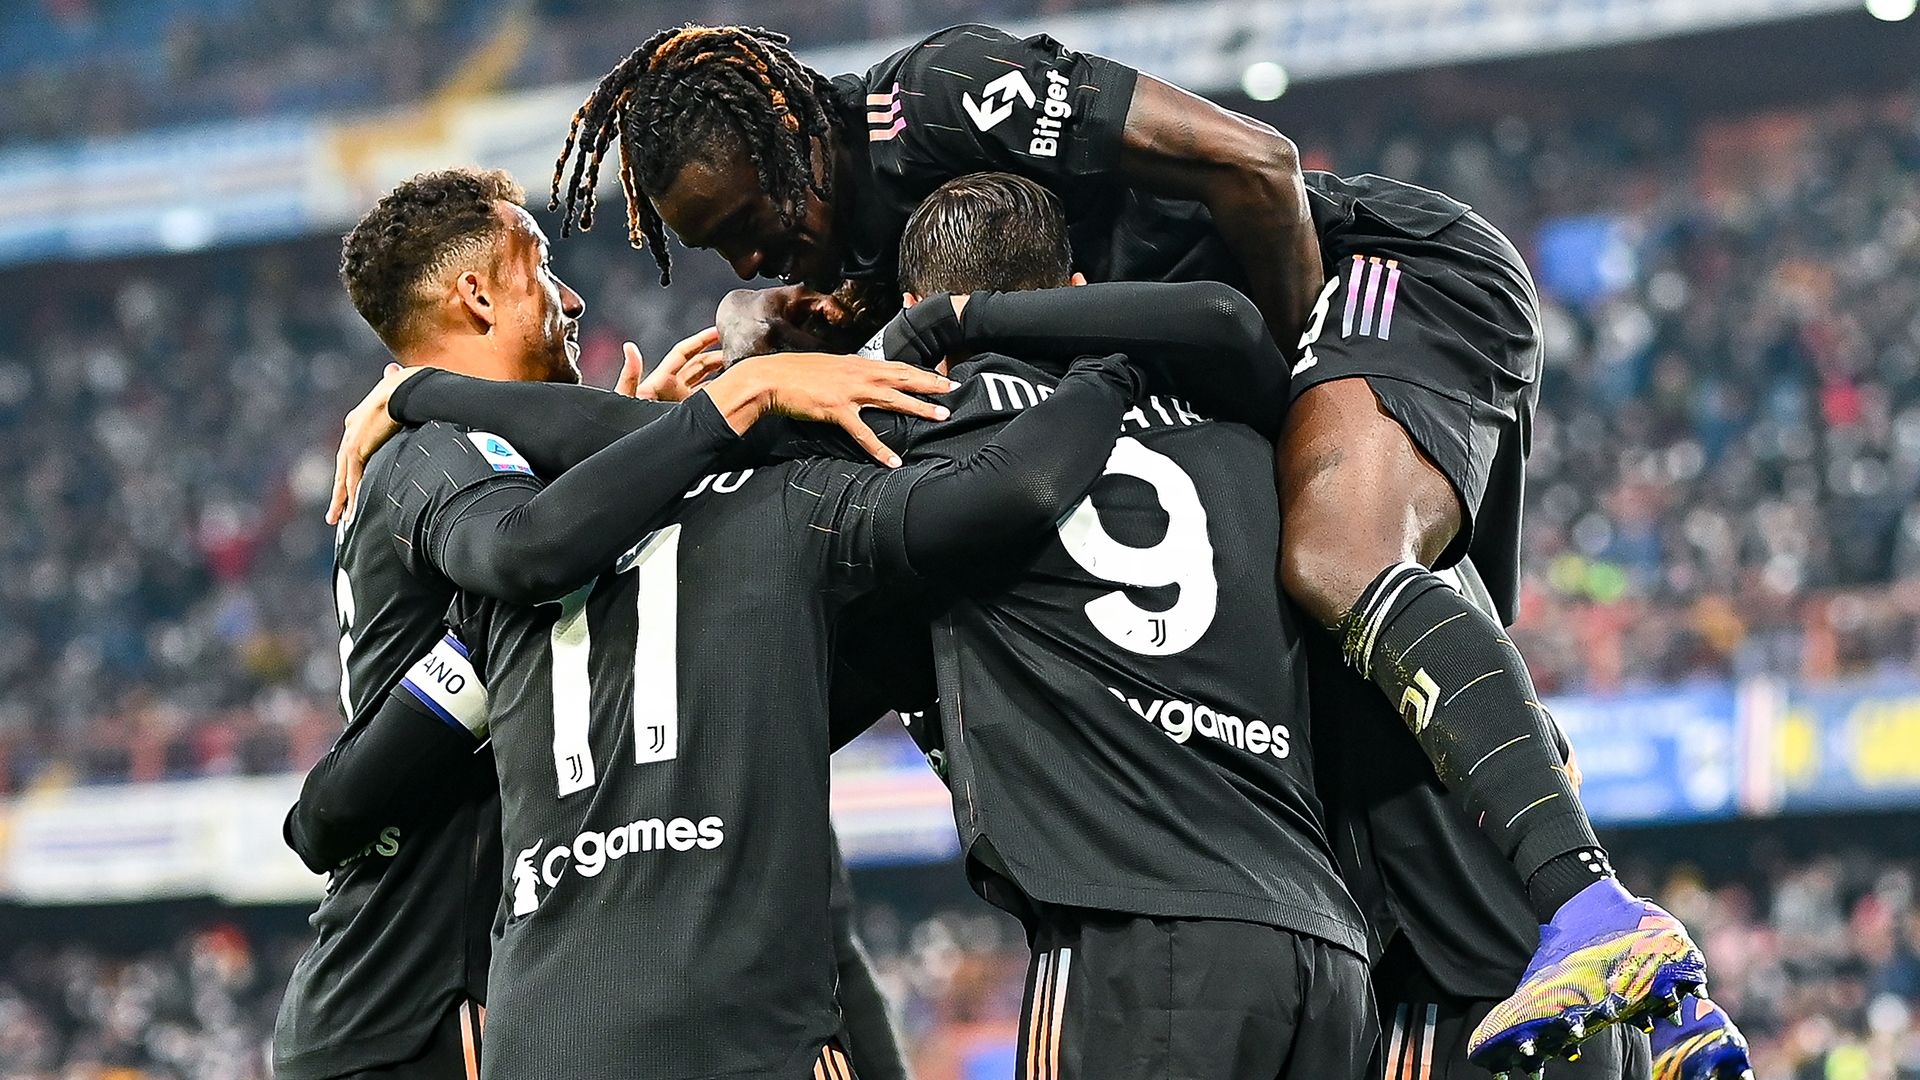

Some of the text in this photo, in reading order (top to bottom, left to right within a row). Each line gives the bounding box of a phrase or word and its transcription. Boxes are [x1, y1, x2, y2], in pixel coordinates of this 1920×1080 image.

[1029, 69, 1072, 157] Bitget
[1056, 435, 1218, 656] 9
[1107, 687, 1290, 759] ygames
[542, 816, 725, 888] Cgames
